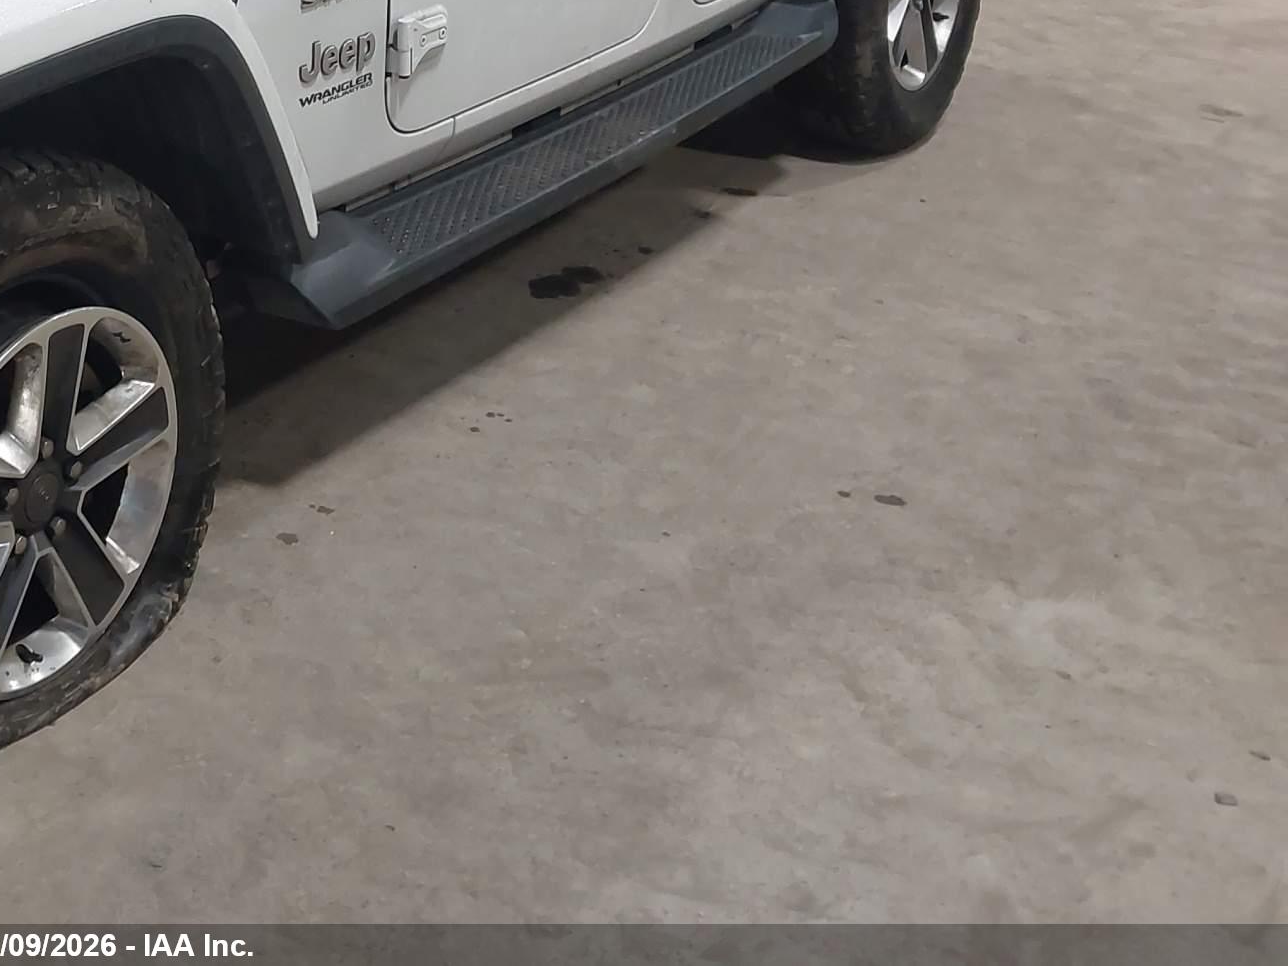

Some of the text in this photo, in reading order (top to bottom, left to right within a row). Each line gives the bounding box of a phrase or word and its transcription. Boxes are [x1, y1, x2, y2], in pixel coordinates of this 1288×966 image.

[299, 32, 375, 84] Jeep
[299, 72, 372, 108] WRANGLER
[323, 81, 373, 105] UNLIMITED
